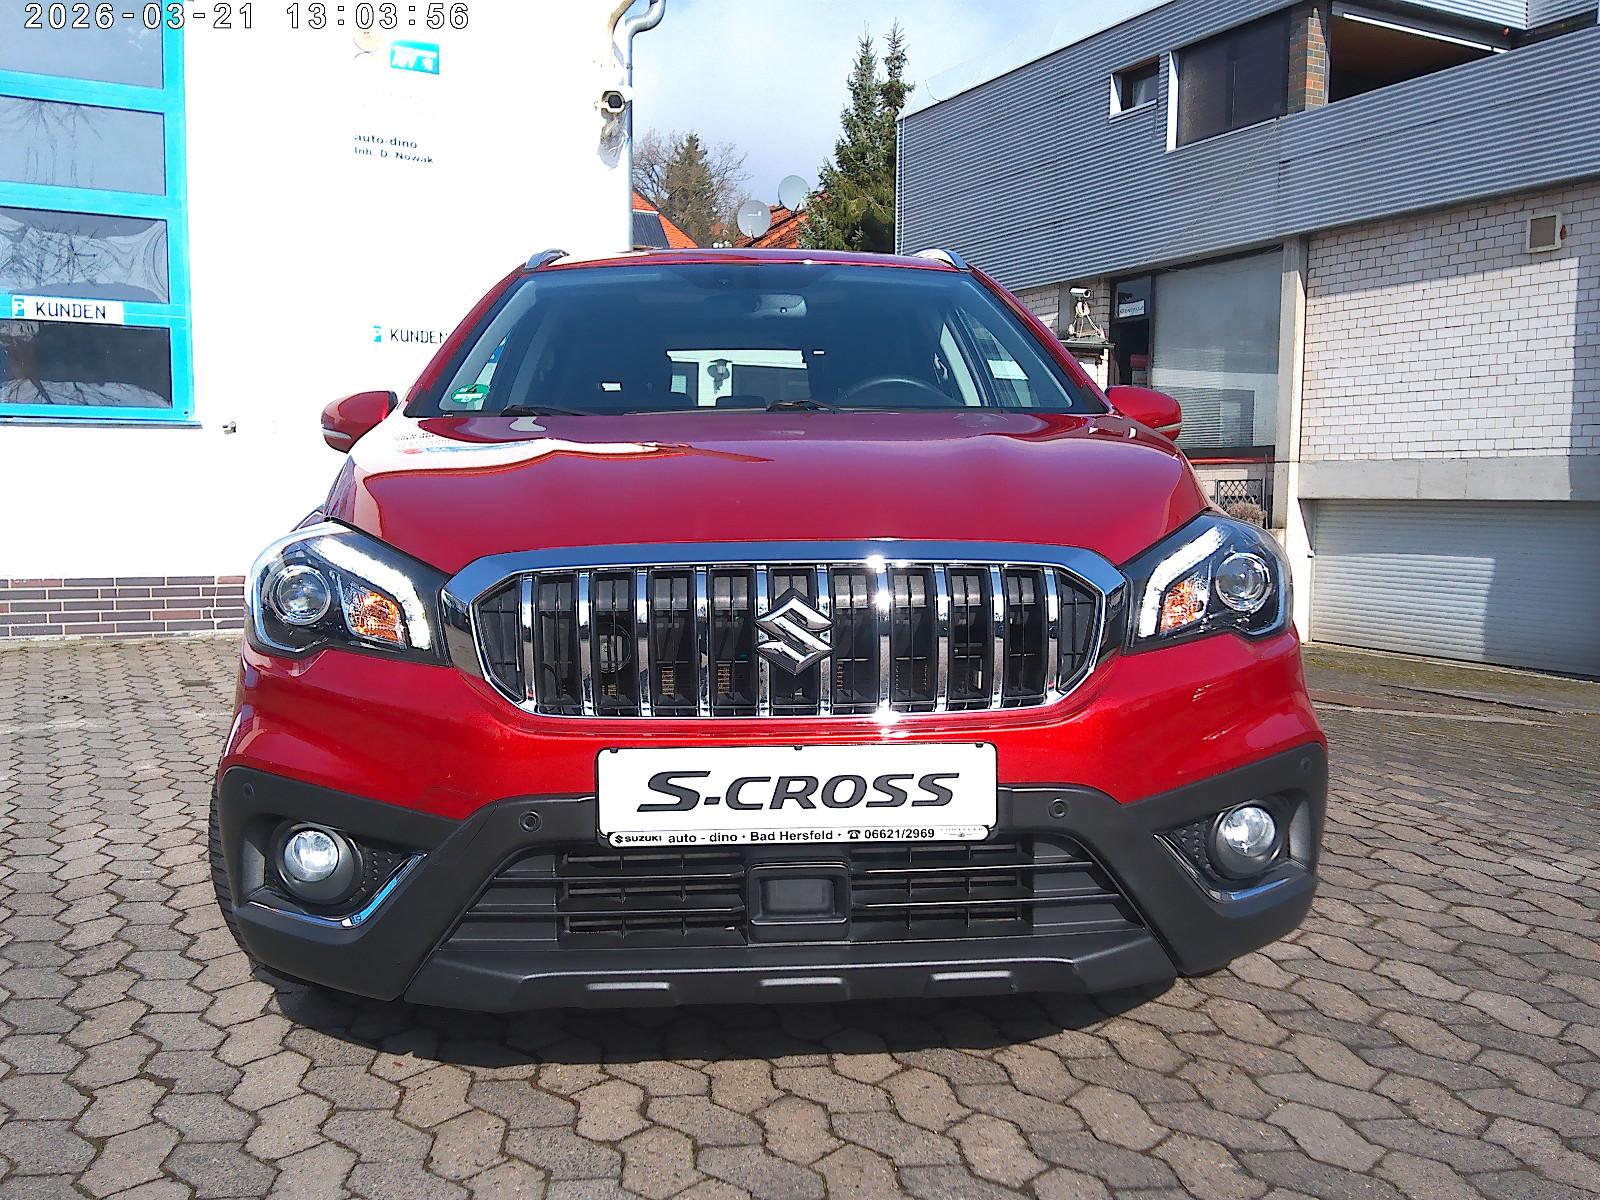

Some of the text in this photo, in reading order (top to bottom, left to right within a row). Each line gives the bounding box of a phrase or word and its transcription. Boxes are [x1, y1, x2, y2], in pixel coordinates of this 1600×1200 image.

[353, 133, 418, 149] auto-dino
[395, 151, 434, 164] Nowak
[35, 301, 106, 319] KUNDEN
[636, 770, 960, 813] S-CROSS
[624, 834, 662, 843] SUZUKI
[668, 834, 697, 844] auto
[709, 831, 738, 843] dino
[750, 831, 776, 842] Bad
[779, 829, 833, 841] Hersfeld
[864, 828, 935, 840] 06621/2969
